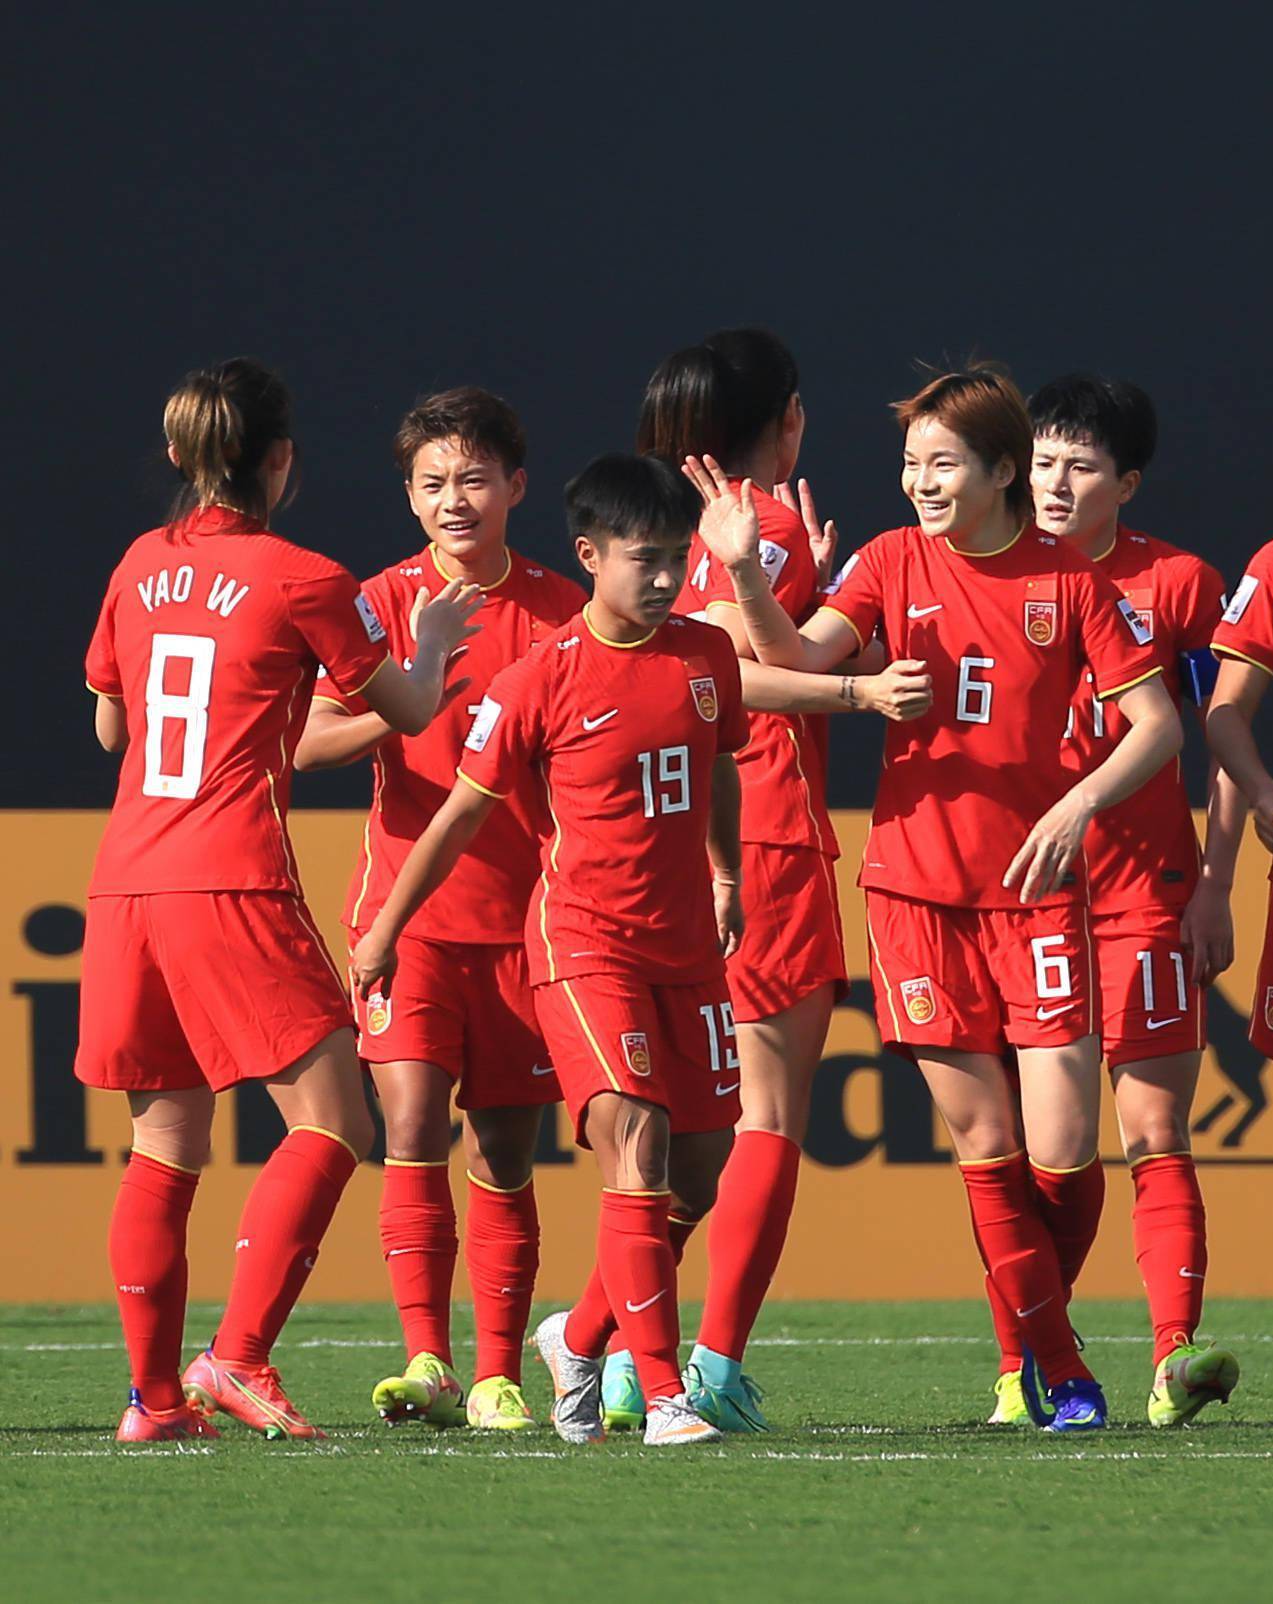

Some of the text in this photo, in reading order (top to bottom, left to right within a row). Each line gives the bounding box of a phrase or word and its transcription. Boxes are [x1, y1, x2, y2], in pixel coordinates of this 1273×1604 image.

[137, 565, 251, 618] YAO W
[142, 633, 216, 800] 8
[955, 656, 996, 725] 6
[637, 745, 691, 818] 19
[1031, 934, 1073, 998] 6
[1136, 951, 1189, 1012] 11
